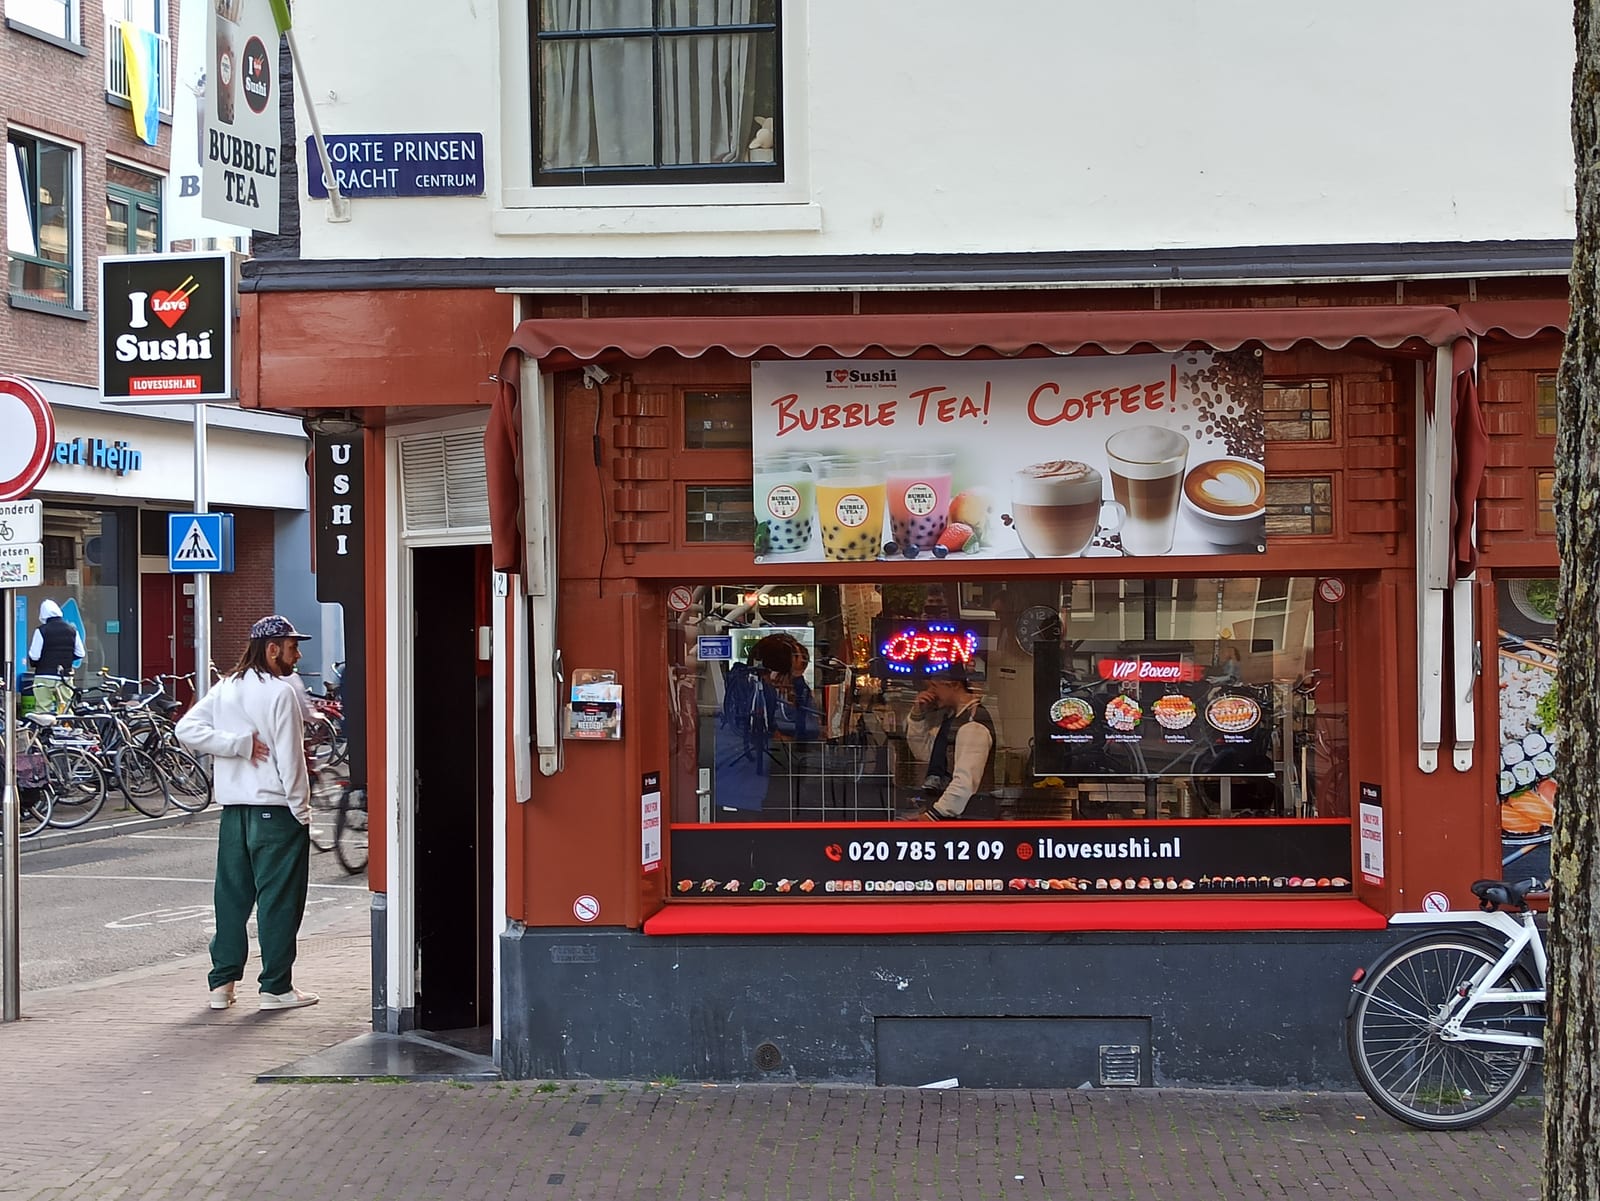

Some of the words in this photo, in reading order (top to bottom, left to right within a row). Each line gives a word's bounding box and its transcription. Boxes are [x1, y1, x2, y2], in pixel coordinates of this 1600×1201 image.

[248, 56, 253, 75] I
[245, 76, 267, 97] Sushi
[208, 128, 277, 178] BUBBLE
[394, 140, 476, 162] PRINSEN
[224, 170, 260, 209] TEA
[415, 174, 477, 188] CENTRUM
[128, 291, 148, 328] I
[153, 298, 188, 312] Love
[115, 332, 213, 362] Sushi
[133, 378, 198, 390] ILOVESUSHI.NL
[826, 370, 833, 383] I
[848, 369, 897, 383] Sushi
[770, 393, 898, 437] BUBBLE
[909, 380, 993, 426] TEA!
[1026, 363, 1178, 427] COFFEE!
[51, 436, 86, 465] ert
[0, 548, 30, 558] etsen
[736, 594, 744, 606] I
[758, 592, 804, 606] Sushi
[888, 635, 971, 663] OPEN
[1112, 661, 1137, 678] VIP
[1139, 661, 1181, 678] Boxen
[848, 841, 890, 862] 020
[896, 840, 937, 861] 785
[944, 840, 971, 861] 12
[977, 840, 1005, 861] 09
[1037, 836, 1181, 859] ilovesushi.nl
